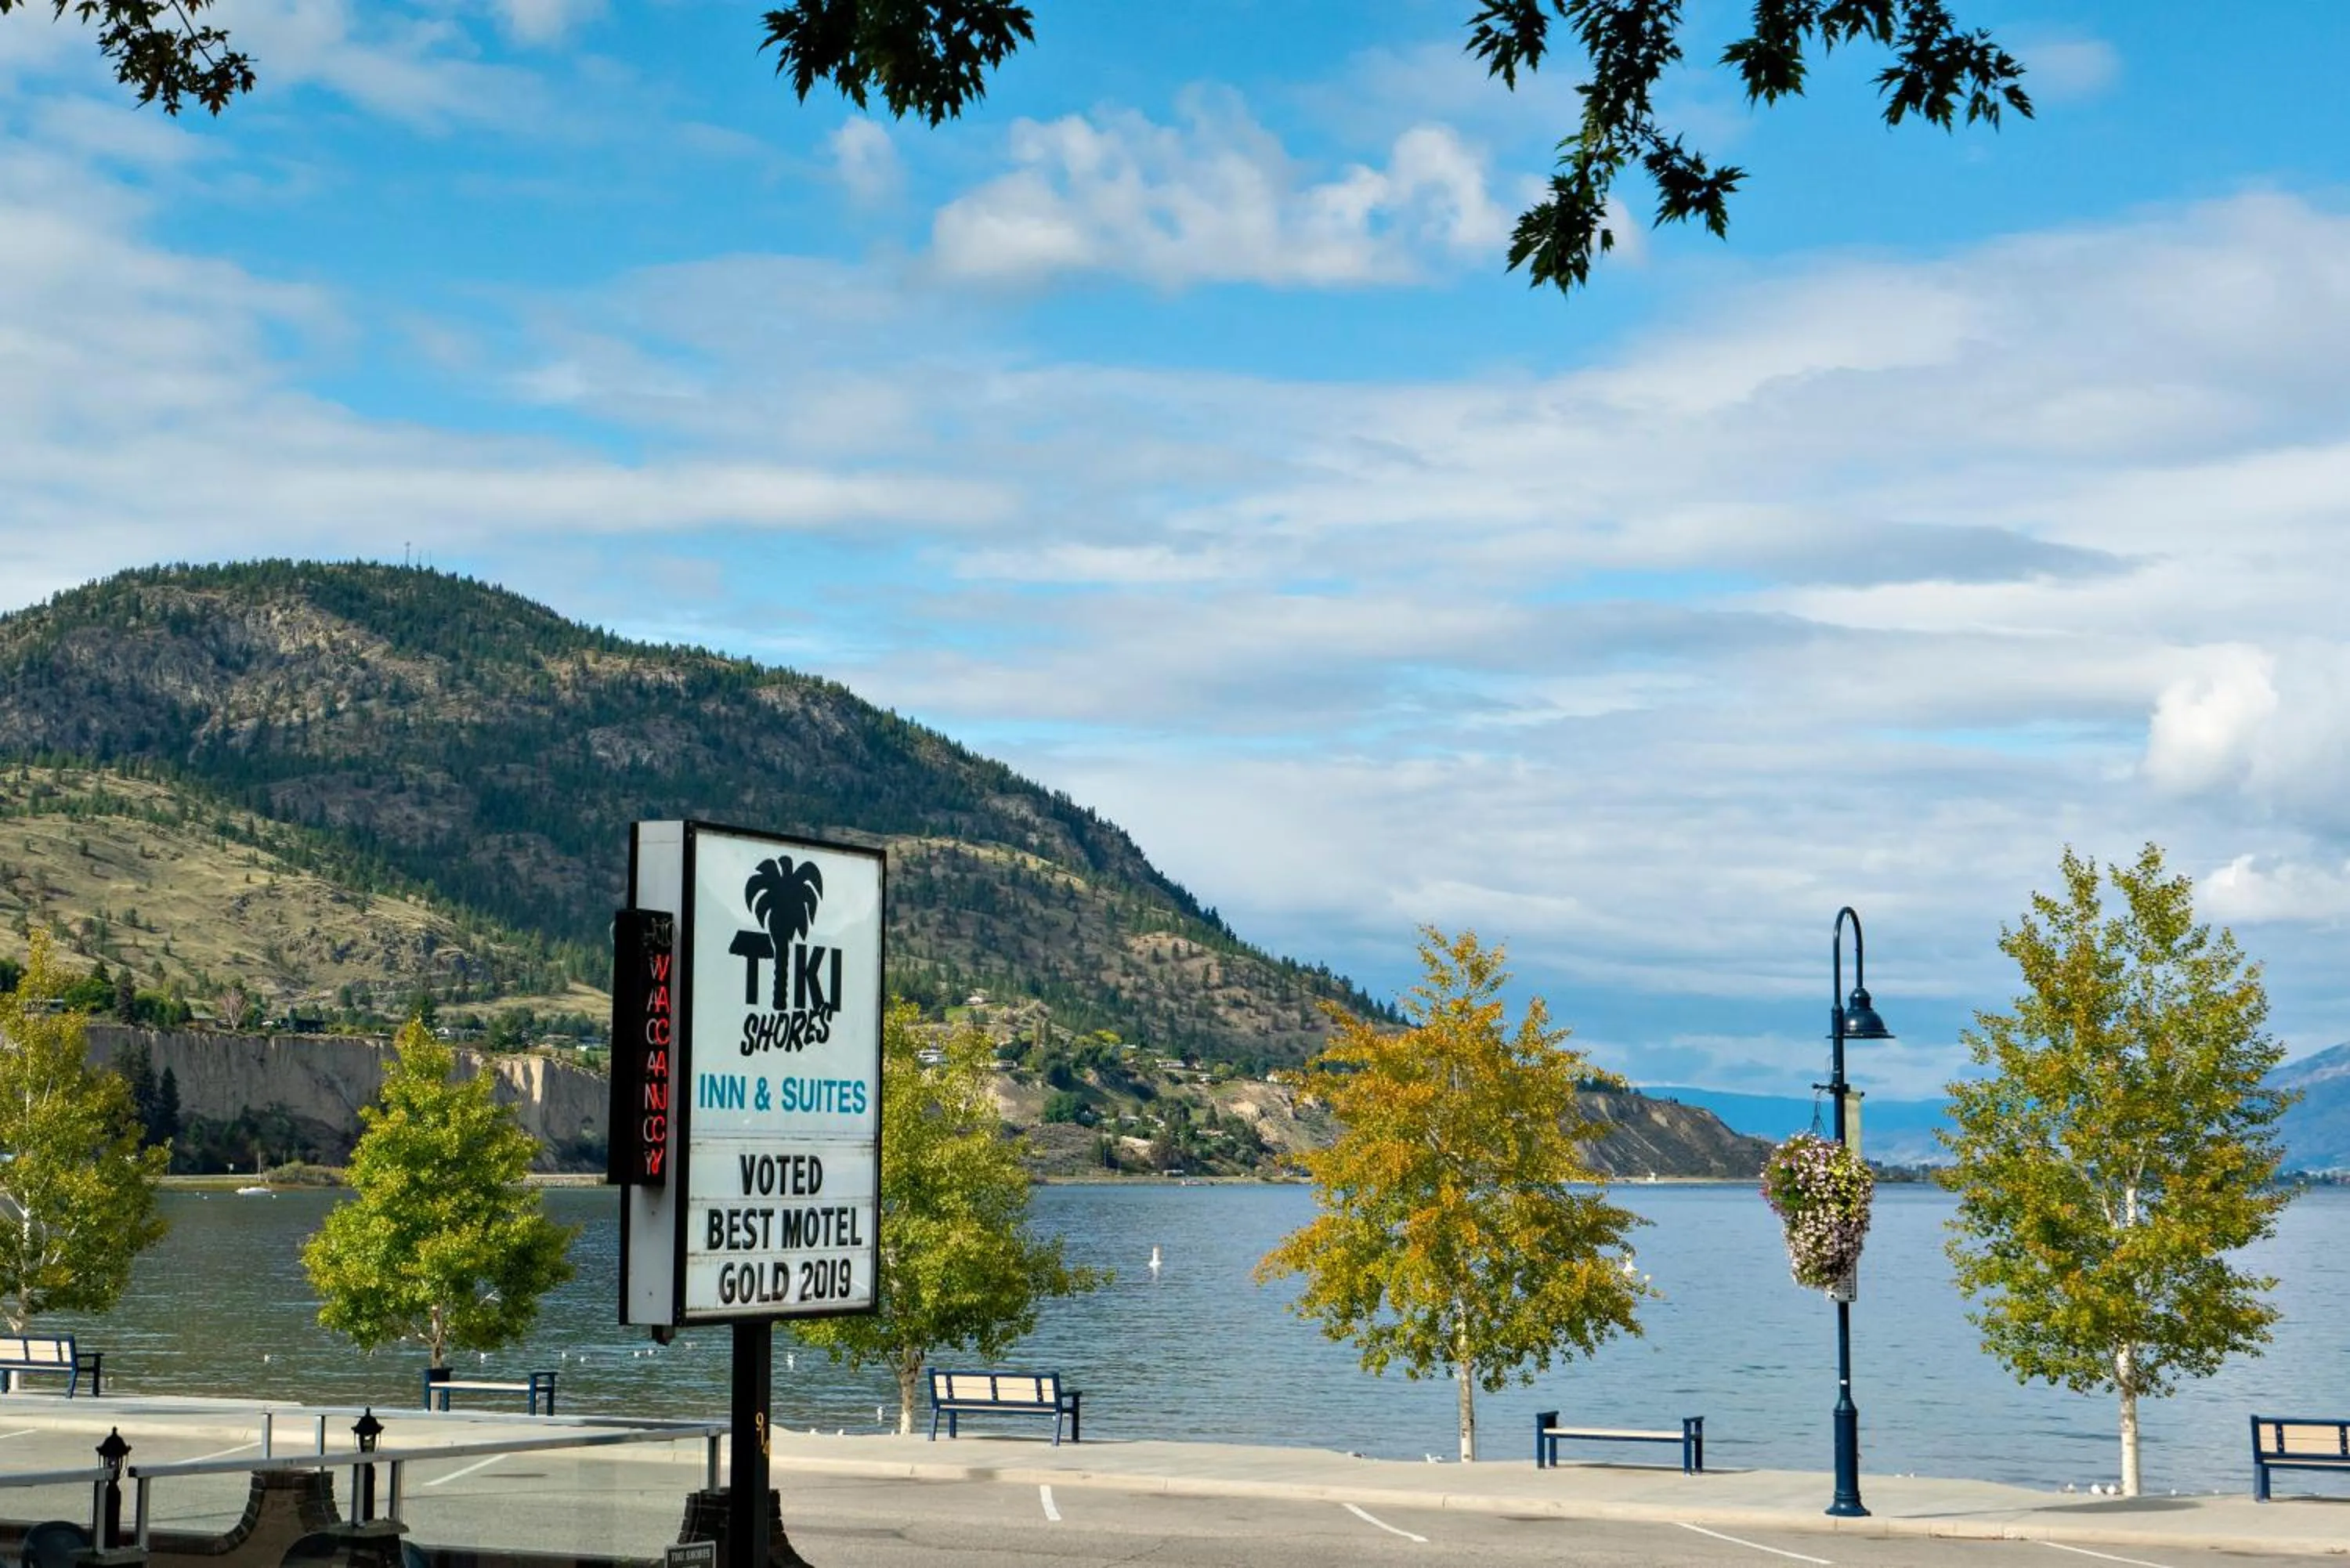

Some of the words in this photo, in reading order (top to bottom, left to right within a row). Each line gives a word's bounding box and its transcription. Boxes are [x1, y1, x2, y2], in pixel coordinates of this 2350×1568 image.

[728, 930, 842, 1012] TIKI
[739, 1003, 833, 1057] SHORES
[644, 953, 671, 1175] VACANCY
[700, 1074, 746, 1110] INN
[754, 1077, 771, 1111] &
[782, 1077, 866, 1115] SUITES
[739, 1154, 822, 1195] VOTED
[707, 1209, 774, 1251] BEST
[782, 1207, 862, 1248] MOTEL
[718, 1261, 790, 1305] GOLD
[799, 1259, 851, 1302] 2019
